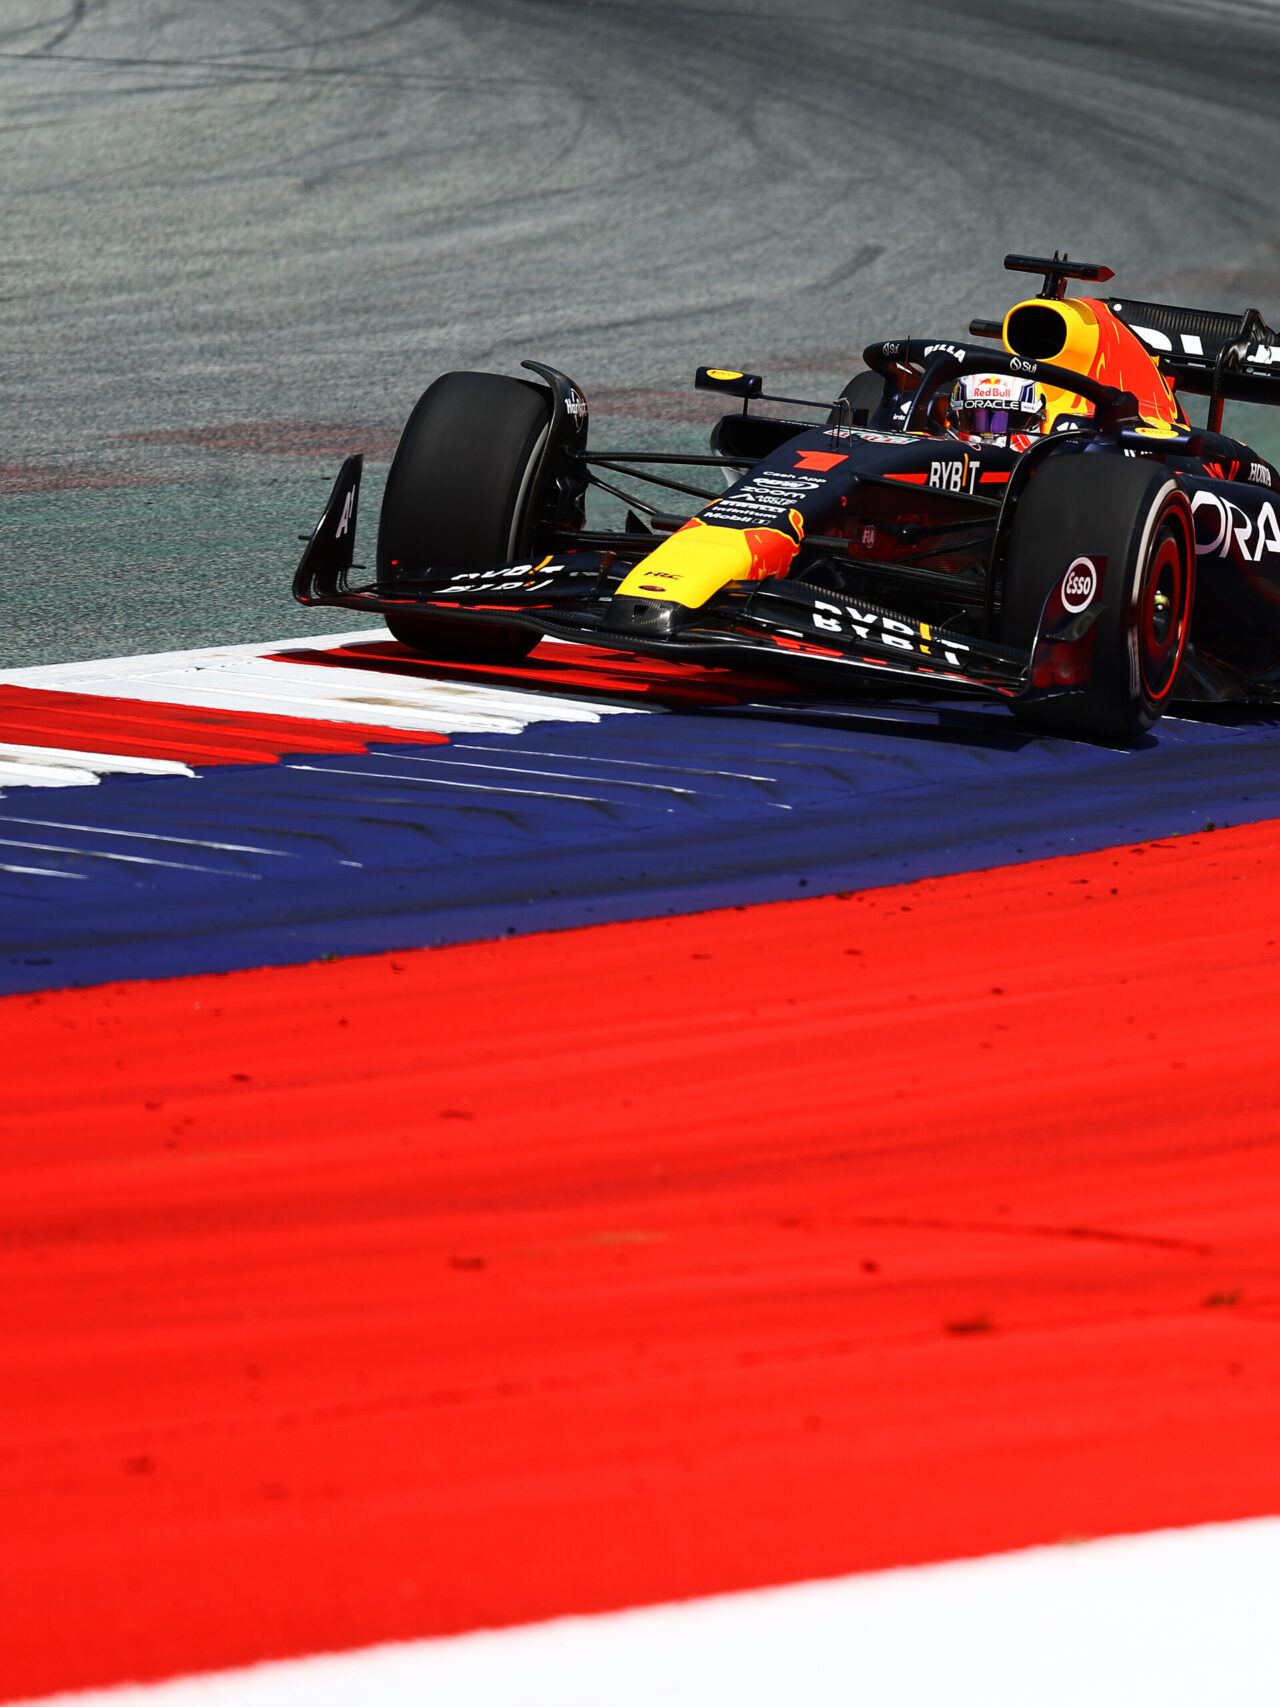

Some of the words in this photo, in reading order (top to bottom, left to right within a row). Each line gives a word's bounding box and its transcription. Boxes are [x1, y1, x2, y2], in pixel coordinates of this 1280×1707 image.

[924, 344, 966, 364] BILLA
[1022, 360, 1038, 374] Sui
[973, 387, 991, 397] Red
[992, 387, 1011, 398] Bull
[964, 400, 1020, 410] ORACLE
[793, 450, 850, 472] 1
[763, 471, 796, 479] Cash
[740, 485, 806, 499] zoom
[703, 511, 753, 523] Mobil
